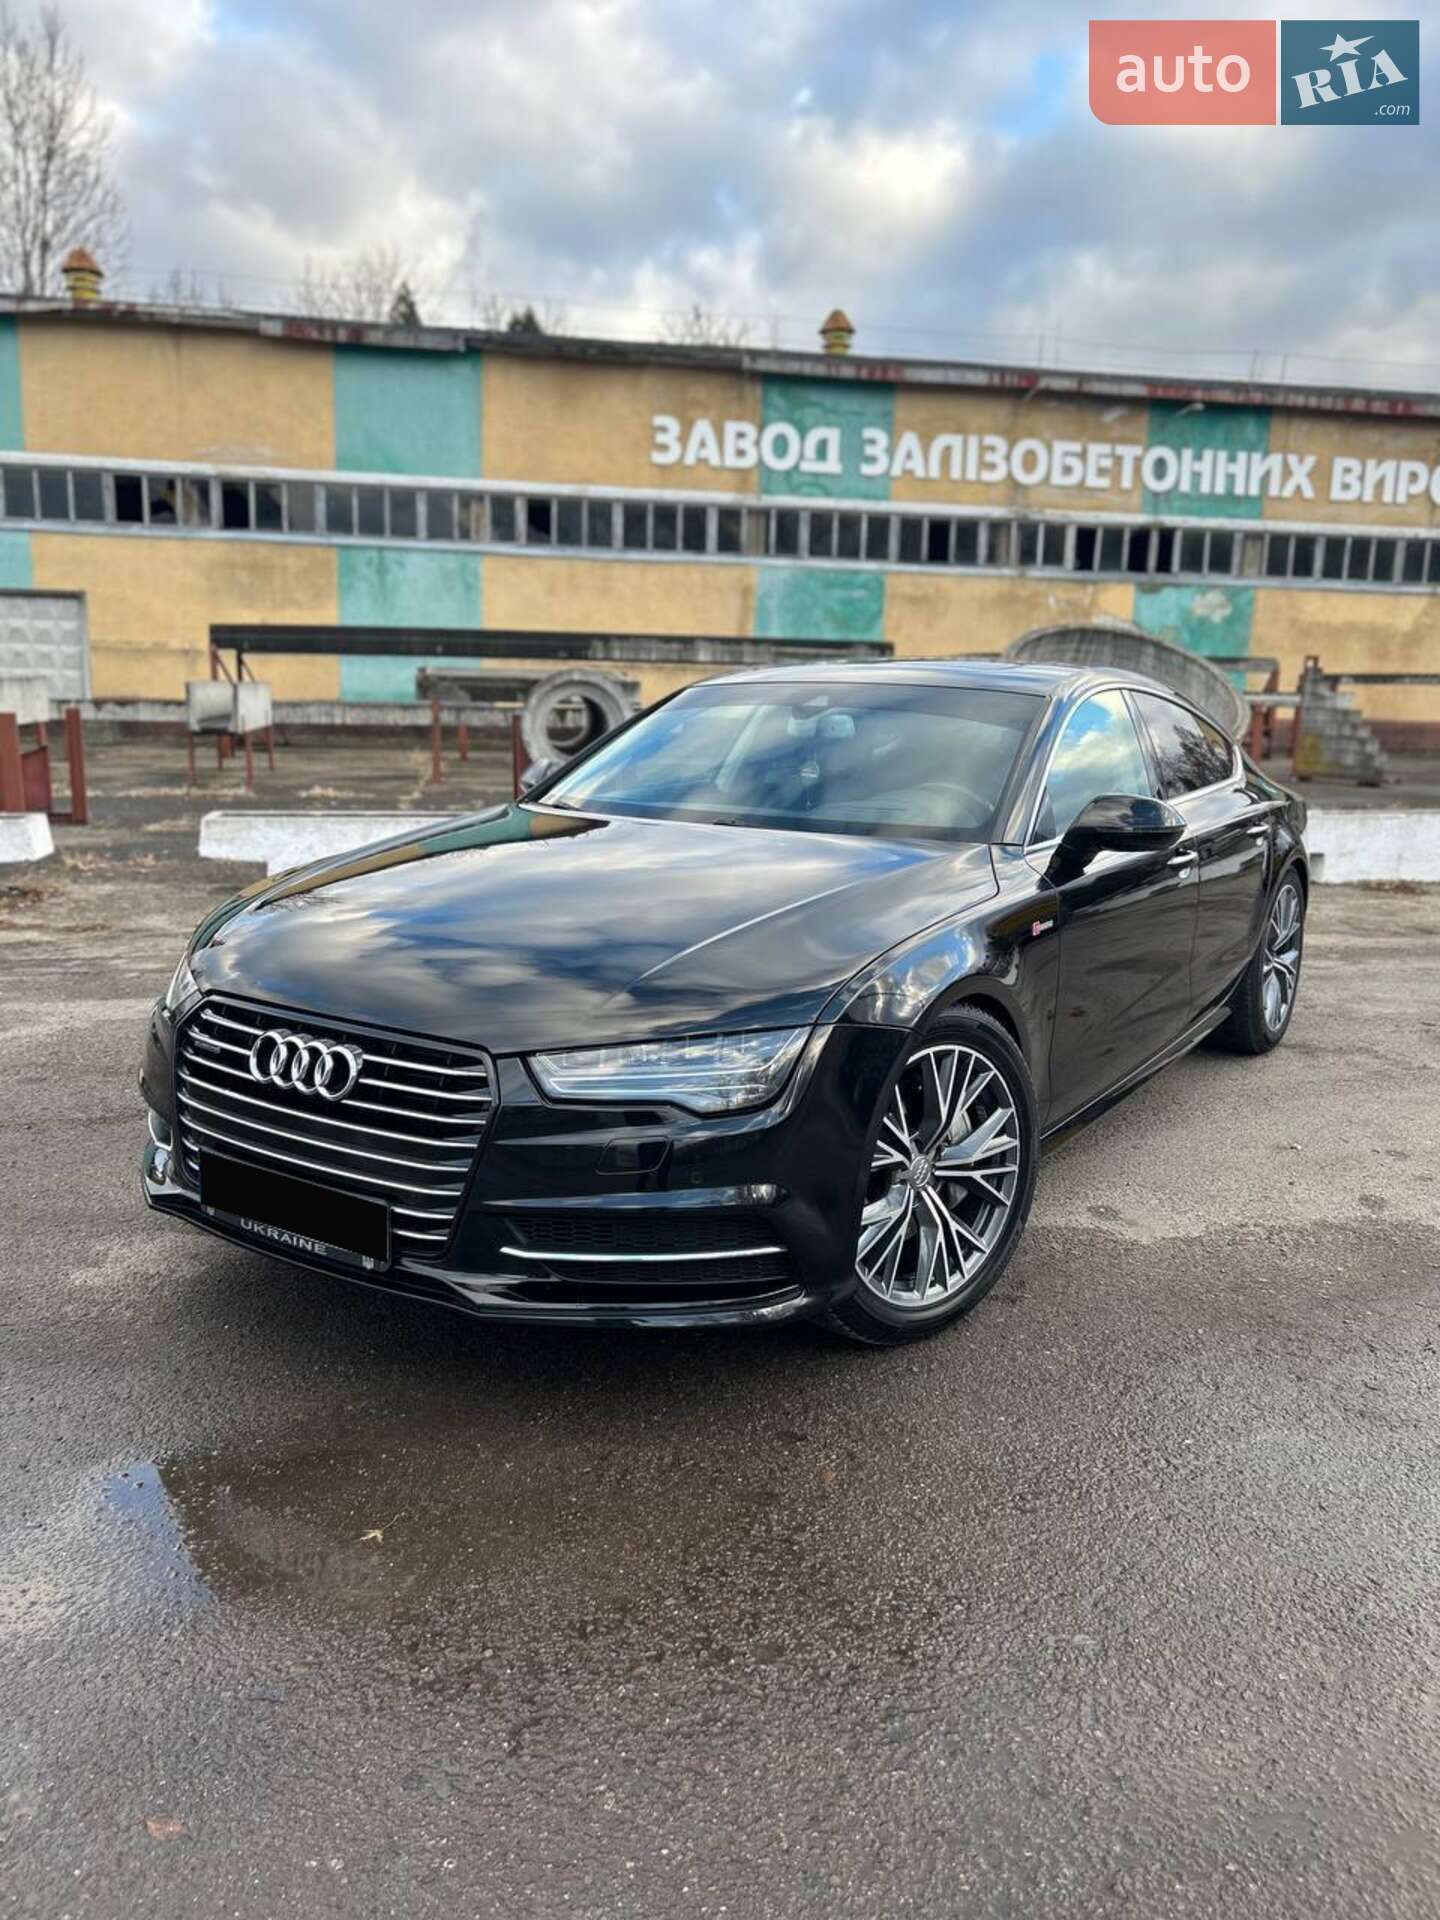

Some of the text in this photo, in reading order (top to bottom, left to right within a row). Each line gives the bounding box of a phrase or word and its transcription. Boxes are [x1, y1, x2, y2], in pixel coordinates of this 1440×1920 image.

[650, 414, 843, 475] ЗАВОД
[860, 427, 1317, 499] ЗАЛІЗОБЕТОННИХ
[240, 1217, 328, 1255] UKRAINE
